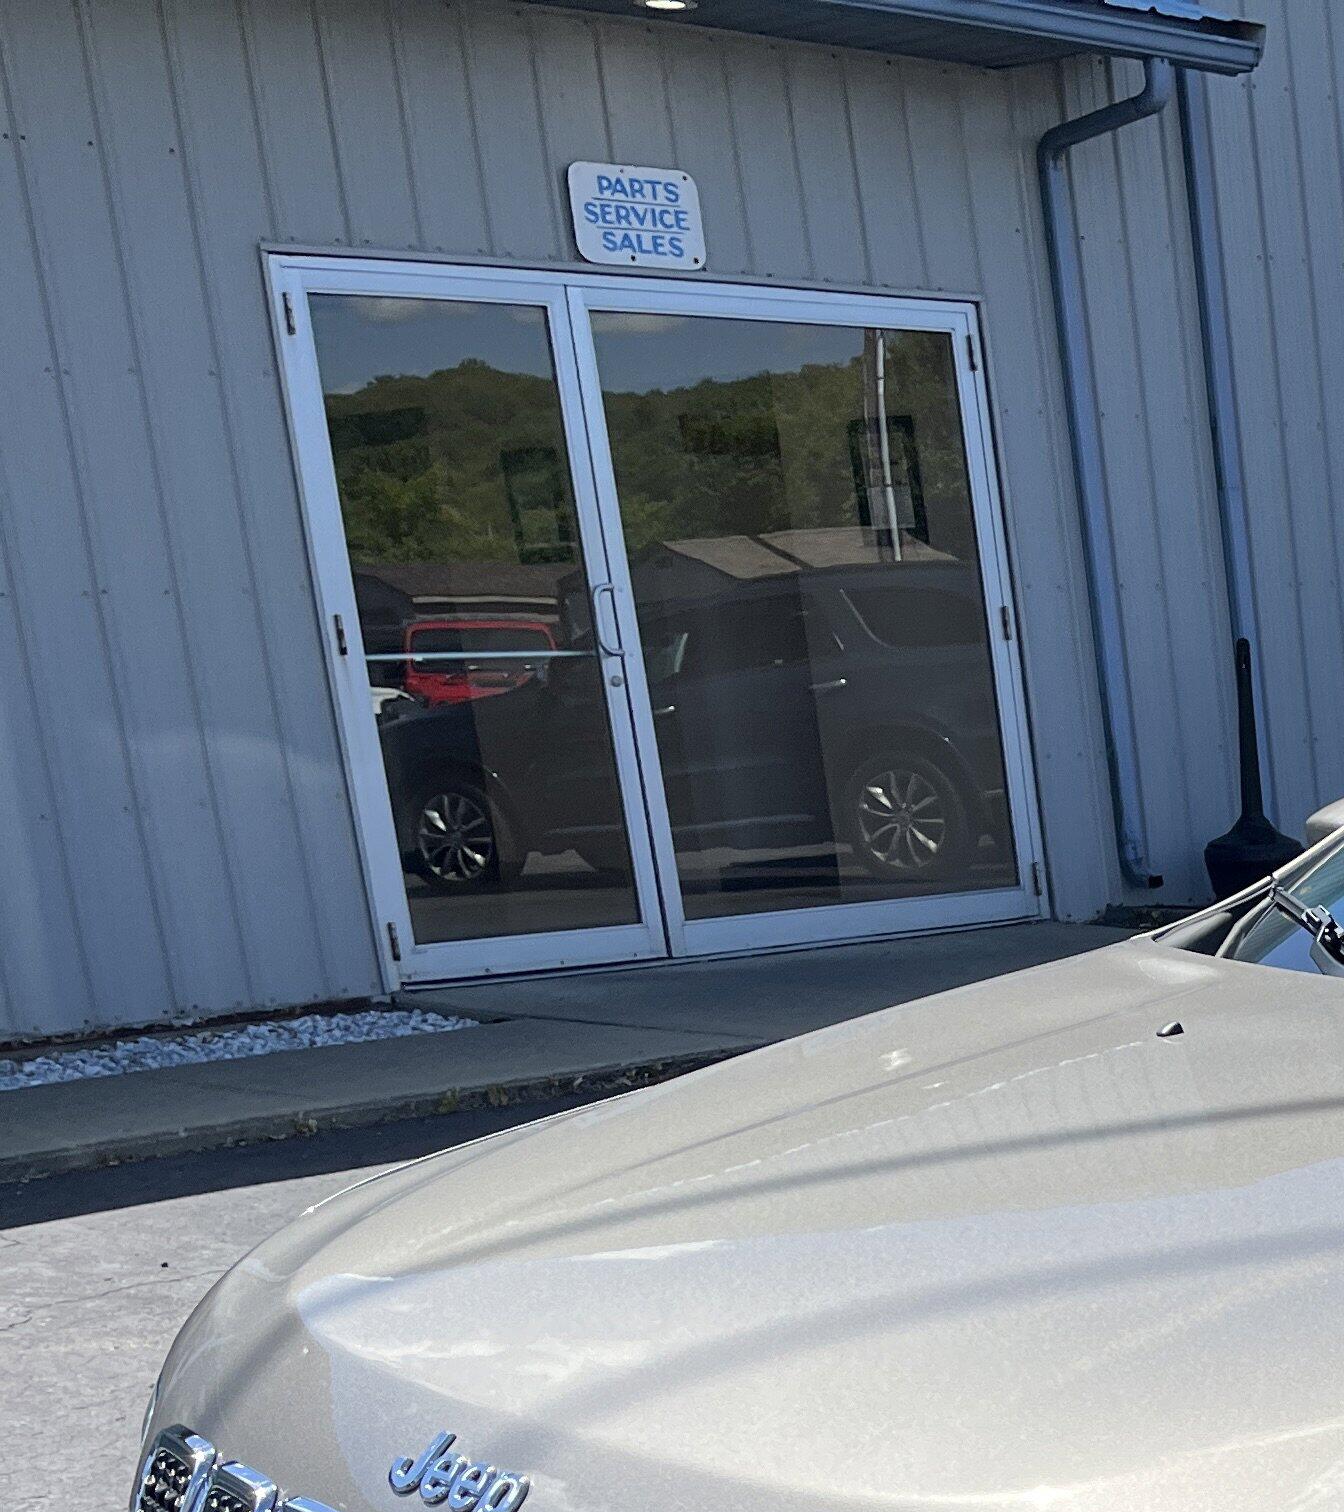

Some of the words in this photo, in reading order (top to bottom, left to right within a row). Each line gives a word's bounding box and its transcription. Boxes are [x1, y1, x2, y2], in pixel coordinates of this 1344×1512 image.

[596, 175, 680, 203] PARTS
[583, 201, 691, 231] SERVICE
[602, 231, 685, 258] SALES
